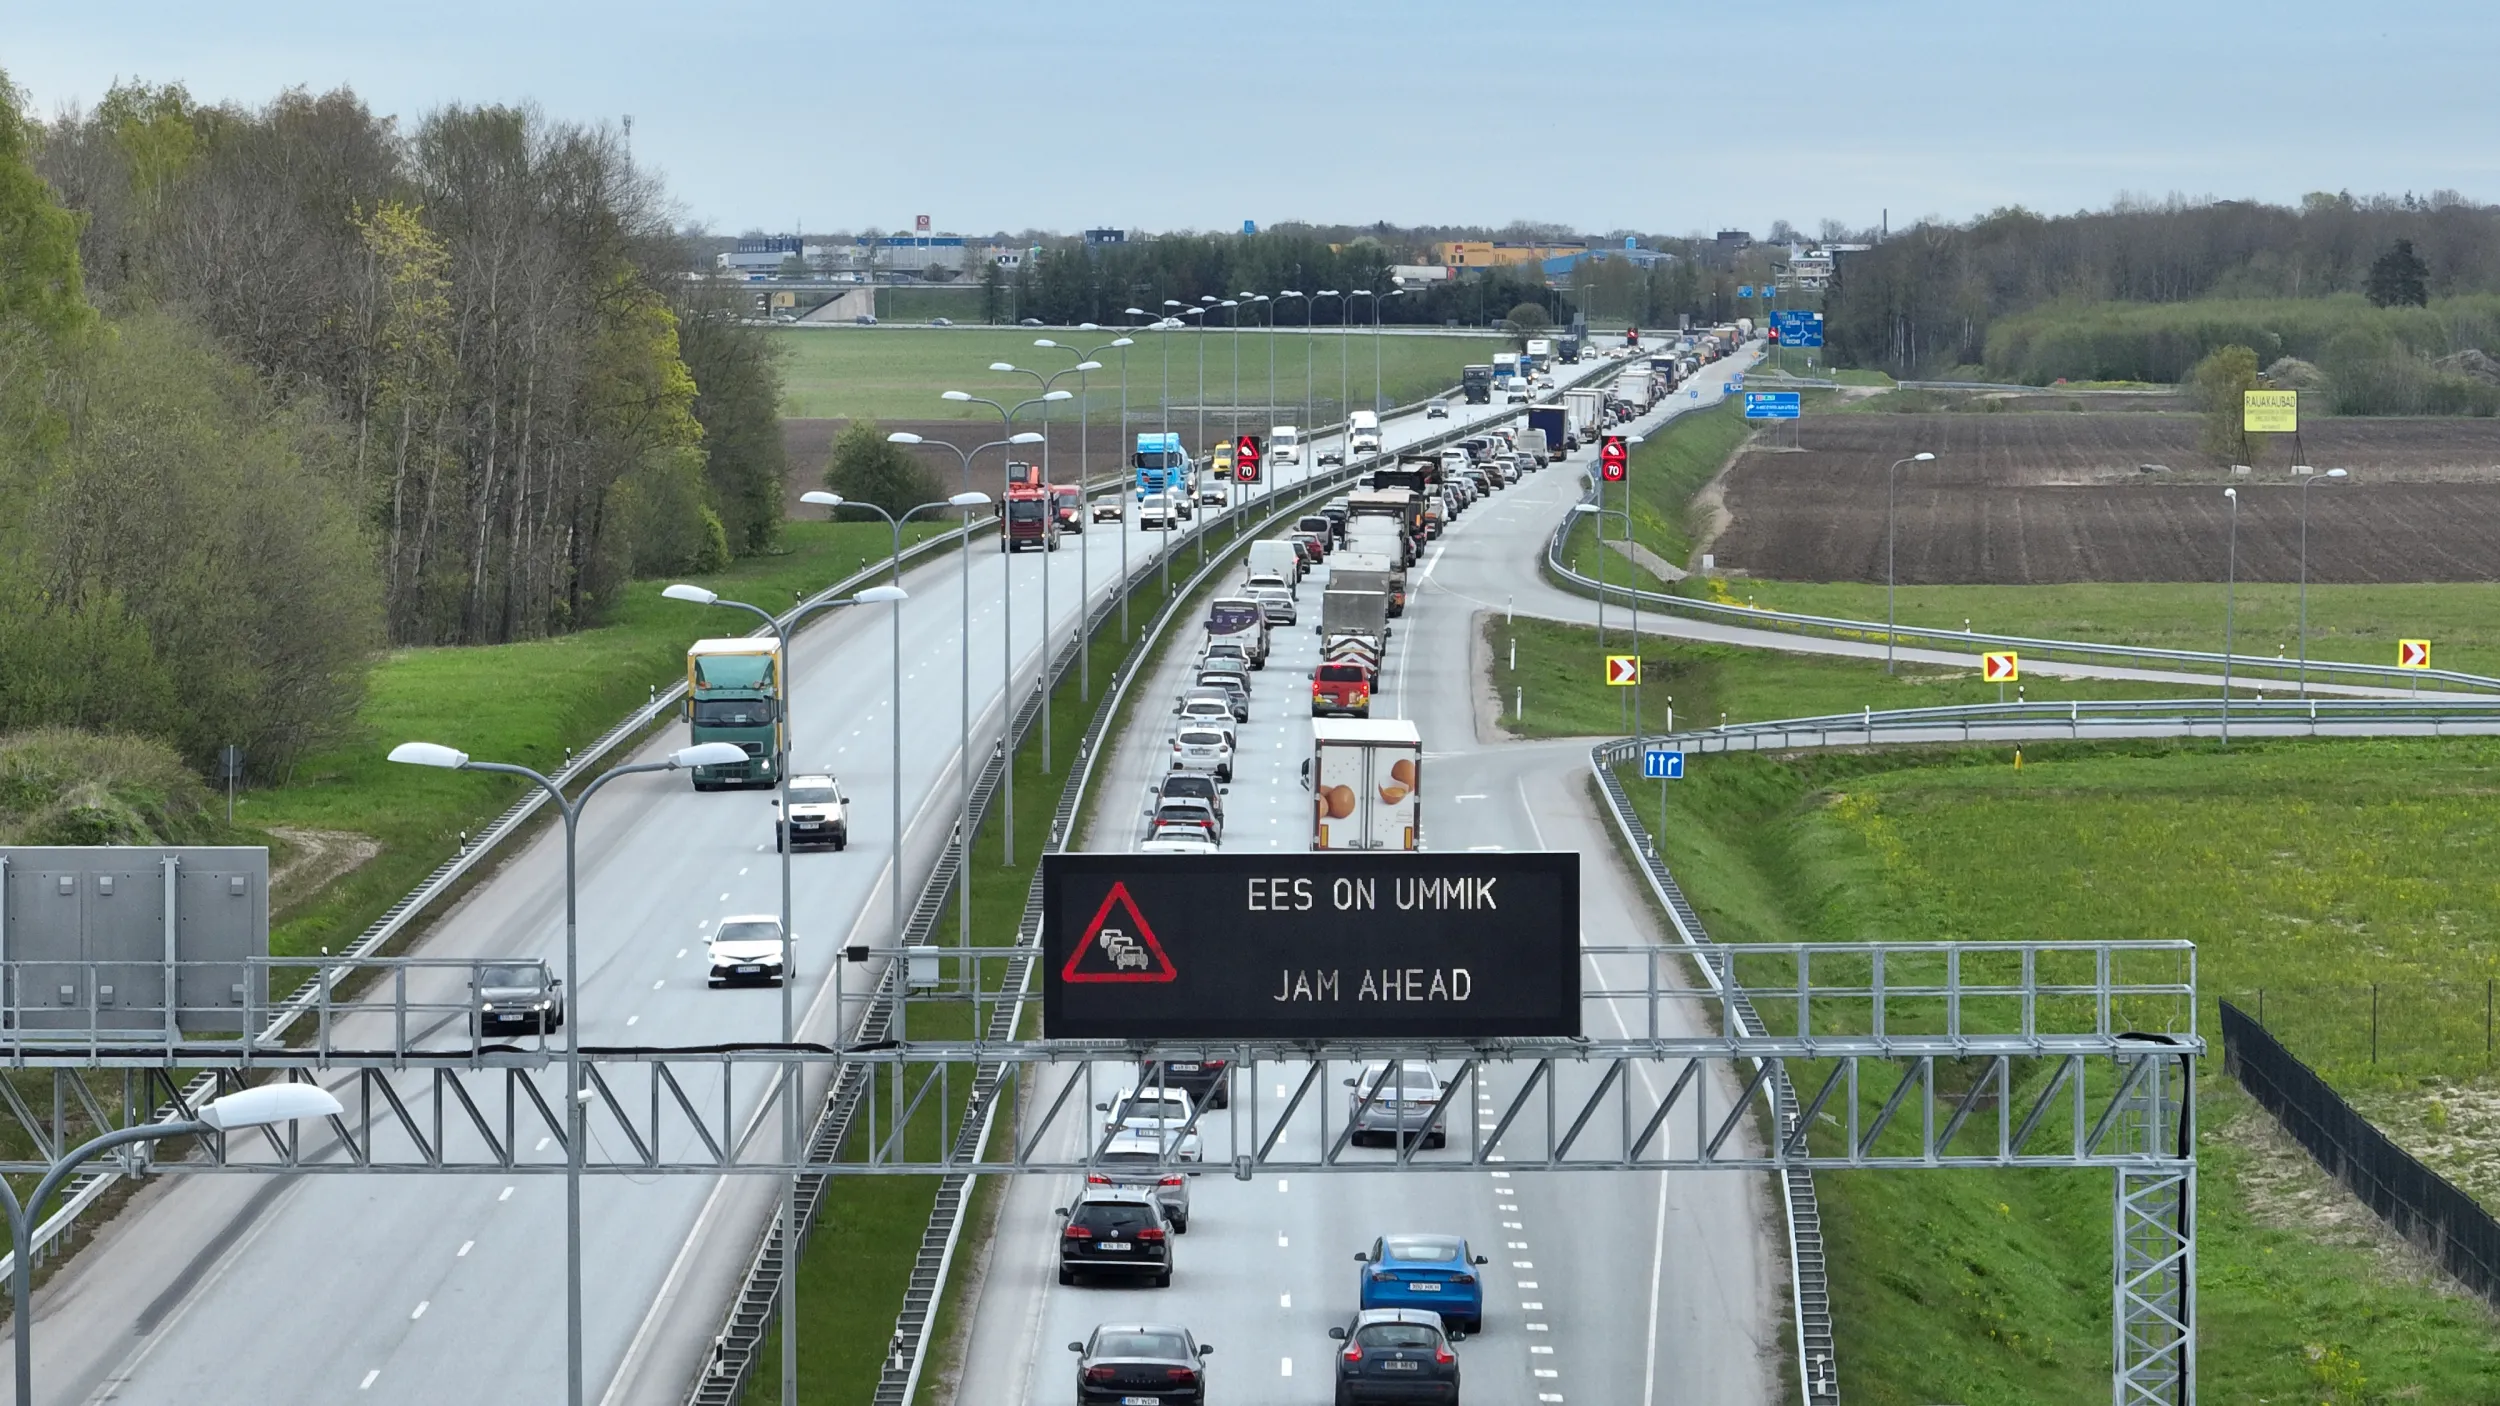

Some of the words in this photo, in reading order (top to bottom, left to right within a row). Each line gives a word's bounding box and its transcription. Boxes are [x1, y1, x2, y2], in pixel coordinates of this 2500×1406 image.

[1242, 466, 1252, 476] 70
[1608, 465, 1619, 476] 70
[1248, 877, 1313, 911] EES
[1333, 877, 1375, 911] ON
[1395, 877, 1497, 911] UMMIK
[1273, 969, 1339, 1002] JAM
[1357, 969, 1470, 1002] AHEAD
